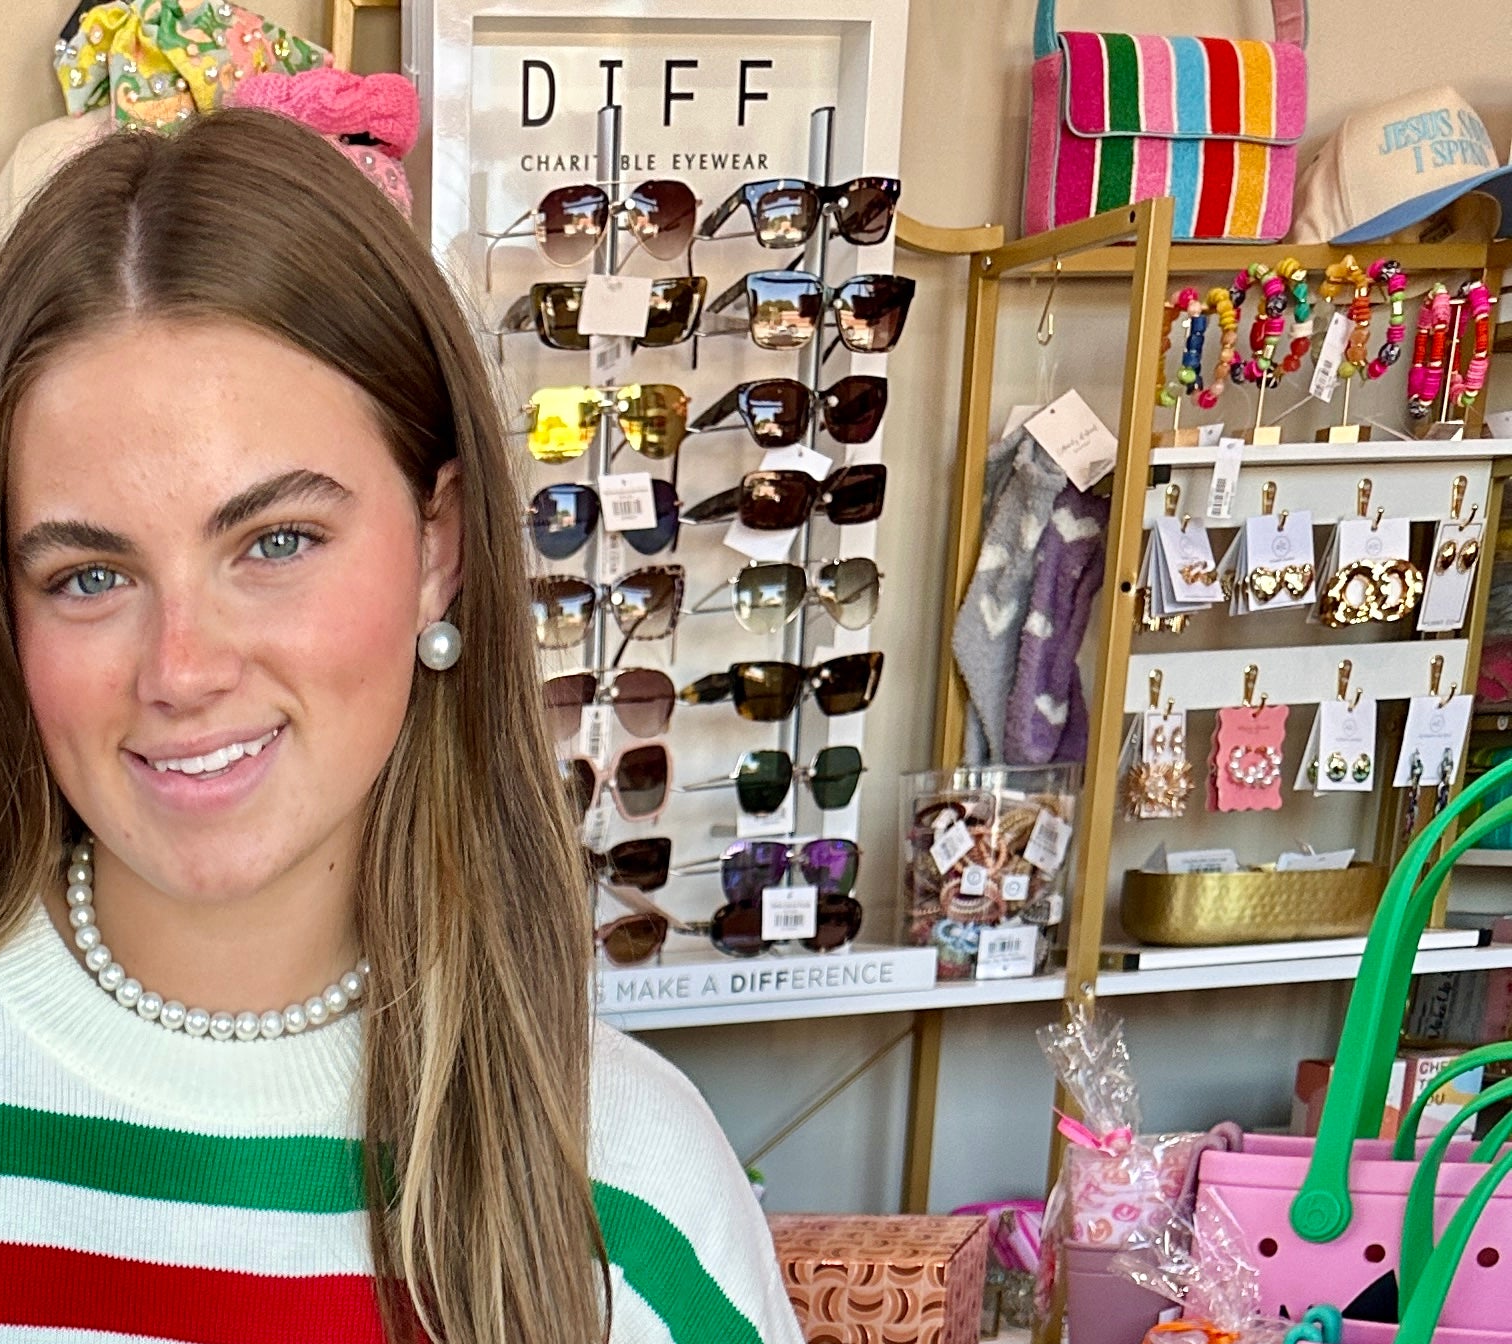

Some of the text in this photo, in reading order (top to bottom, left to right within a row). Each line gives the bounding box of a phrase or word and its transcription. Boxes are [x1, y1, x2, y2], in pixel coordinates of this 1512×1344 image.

[521, 59, 773, 128] DIFF
[1378, 108, 1454, 155] JESUS
[521, 153, 769, 172] CHARIBLE EYEWEAR
[616, 976, 691, 1003] MAKE
[701, 972, 718, 995] A
[730, 961, 896, 994] DIFFERENCE
[1418, 1060, 1451, 1076] CHE
